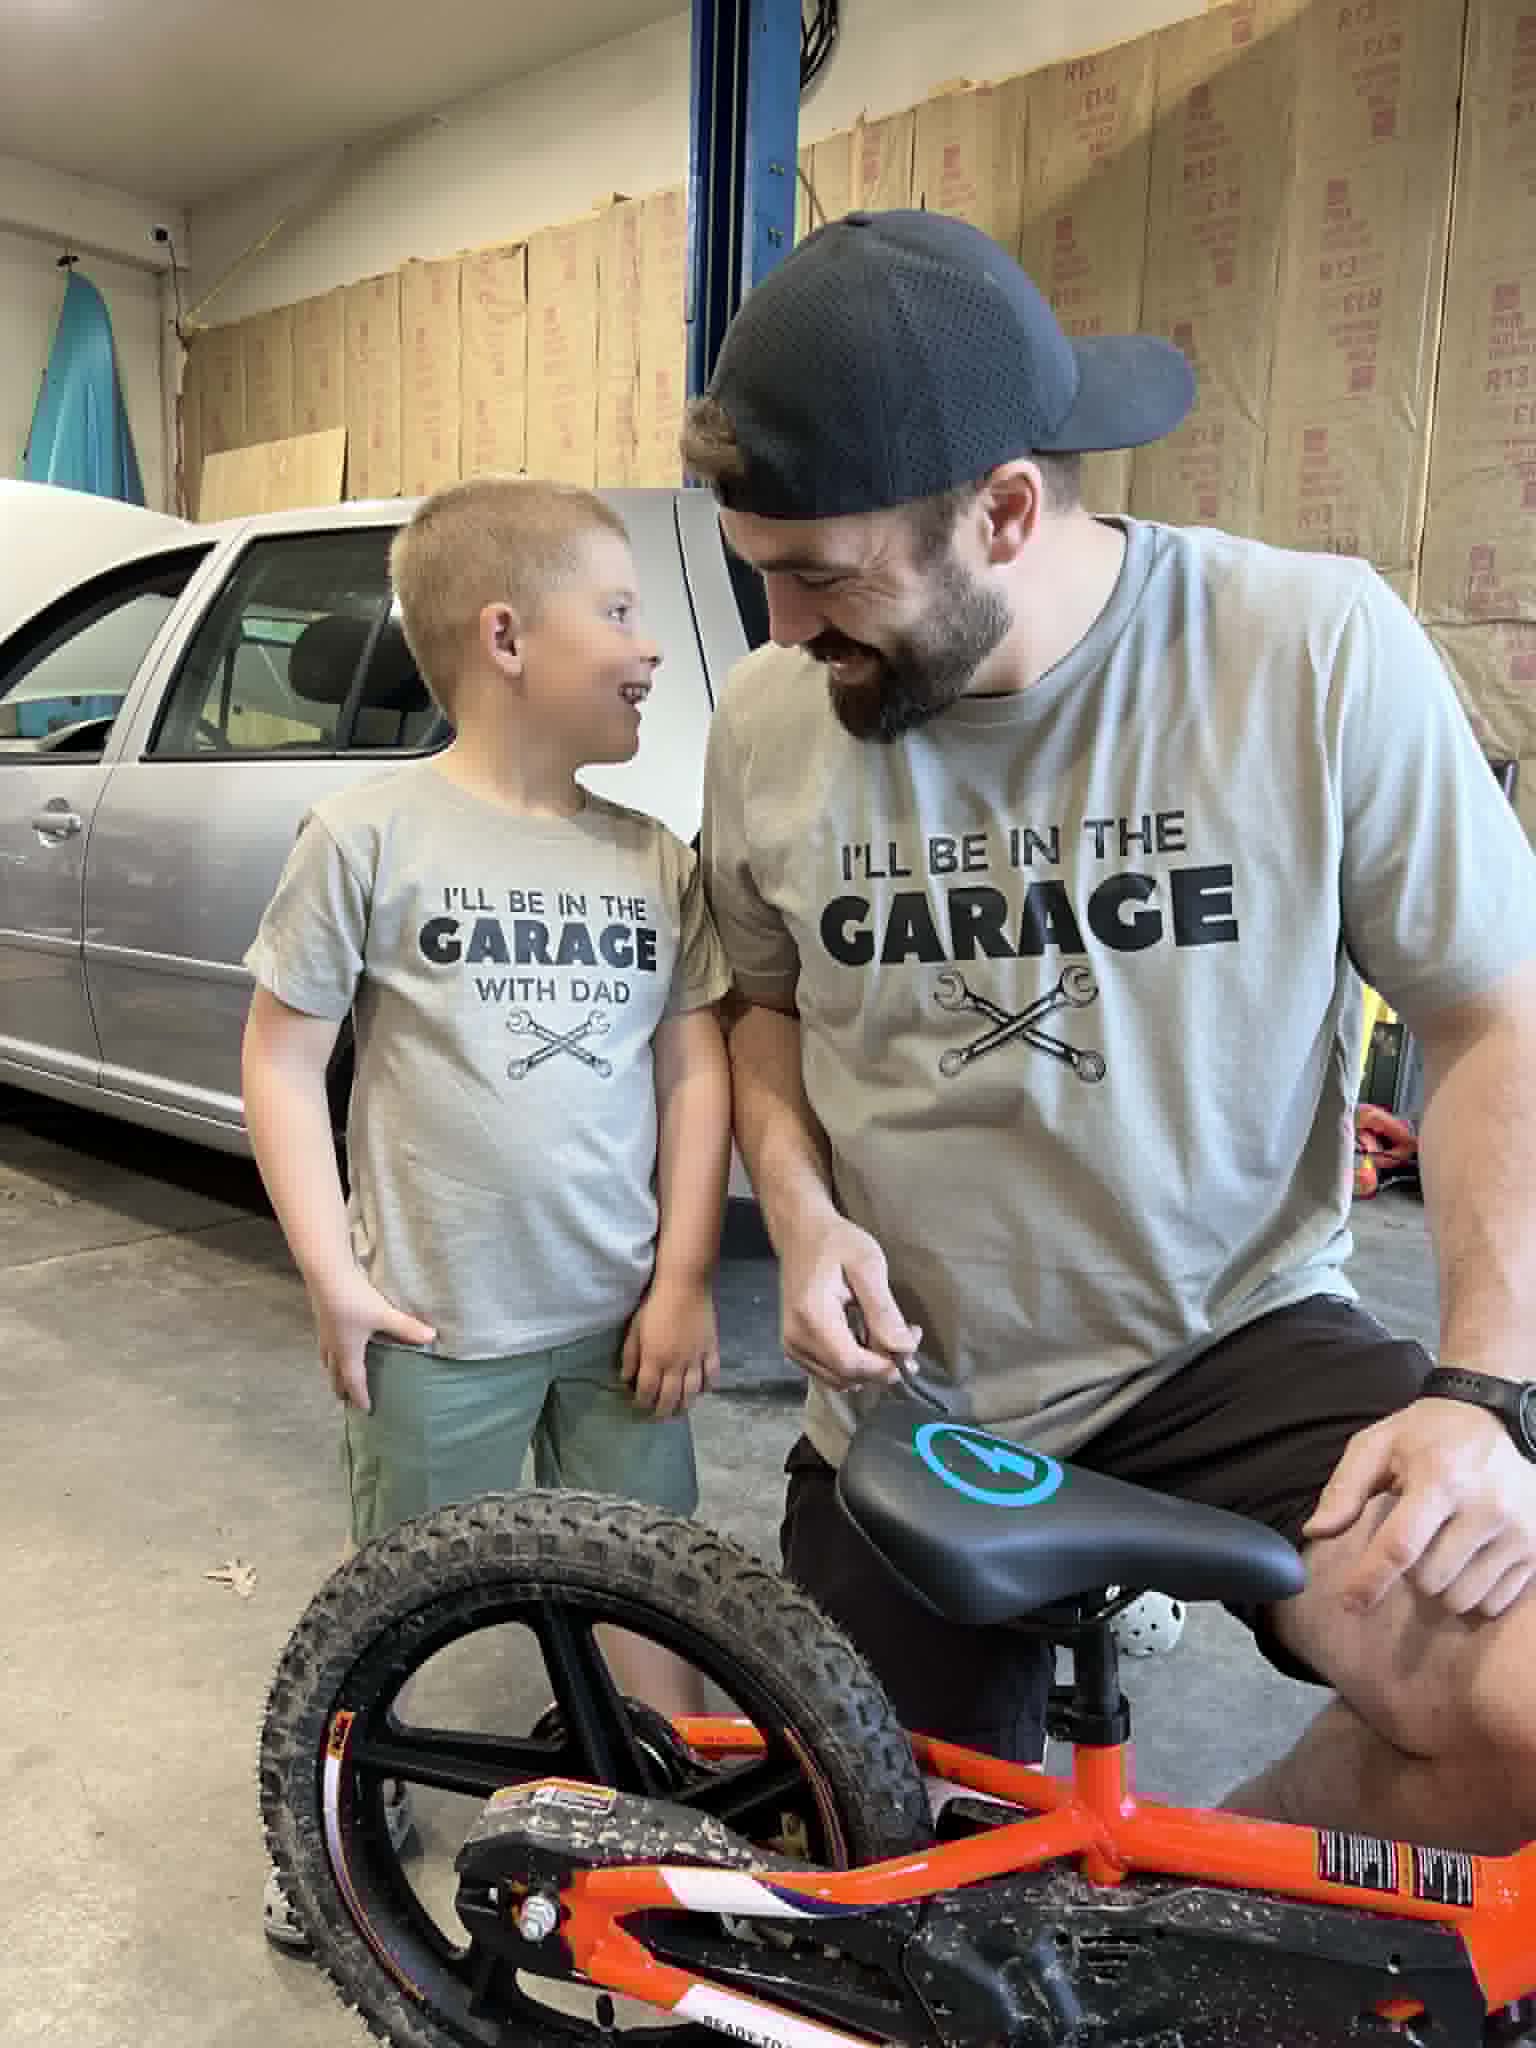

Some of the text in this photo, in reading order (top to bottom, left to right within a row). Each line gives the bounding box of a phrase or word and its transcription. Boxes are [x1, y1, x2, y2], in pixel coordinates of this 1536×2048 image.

[842, 810, 1186, 880] I'LL BE IN THE
[444, 887, 648, 921] I'LL BE IN THE
[820, 864, 1239, 967] GARAGE
[419, 917, 657, 972] GARAGE
[475, 978, 630, 1004] WITH DAD
